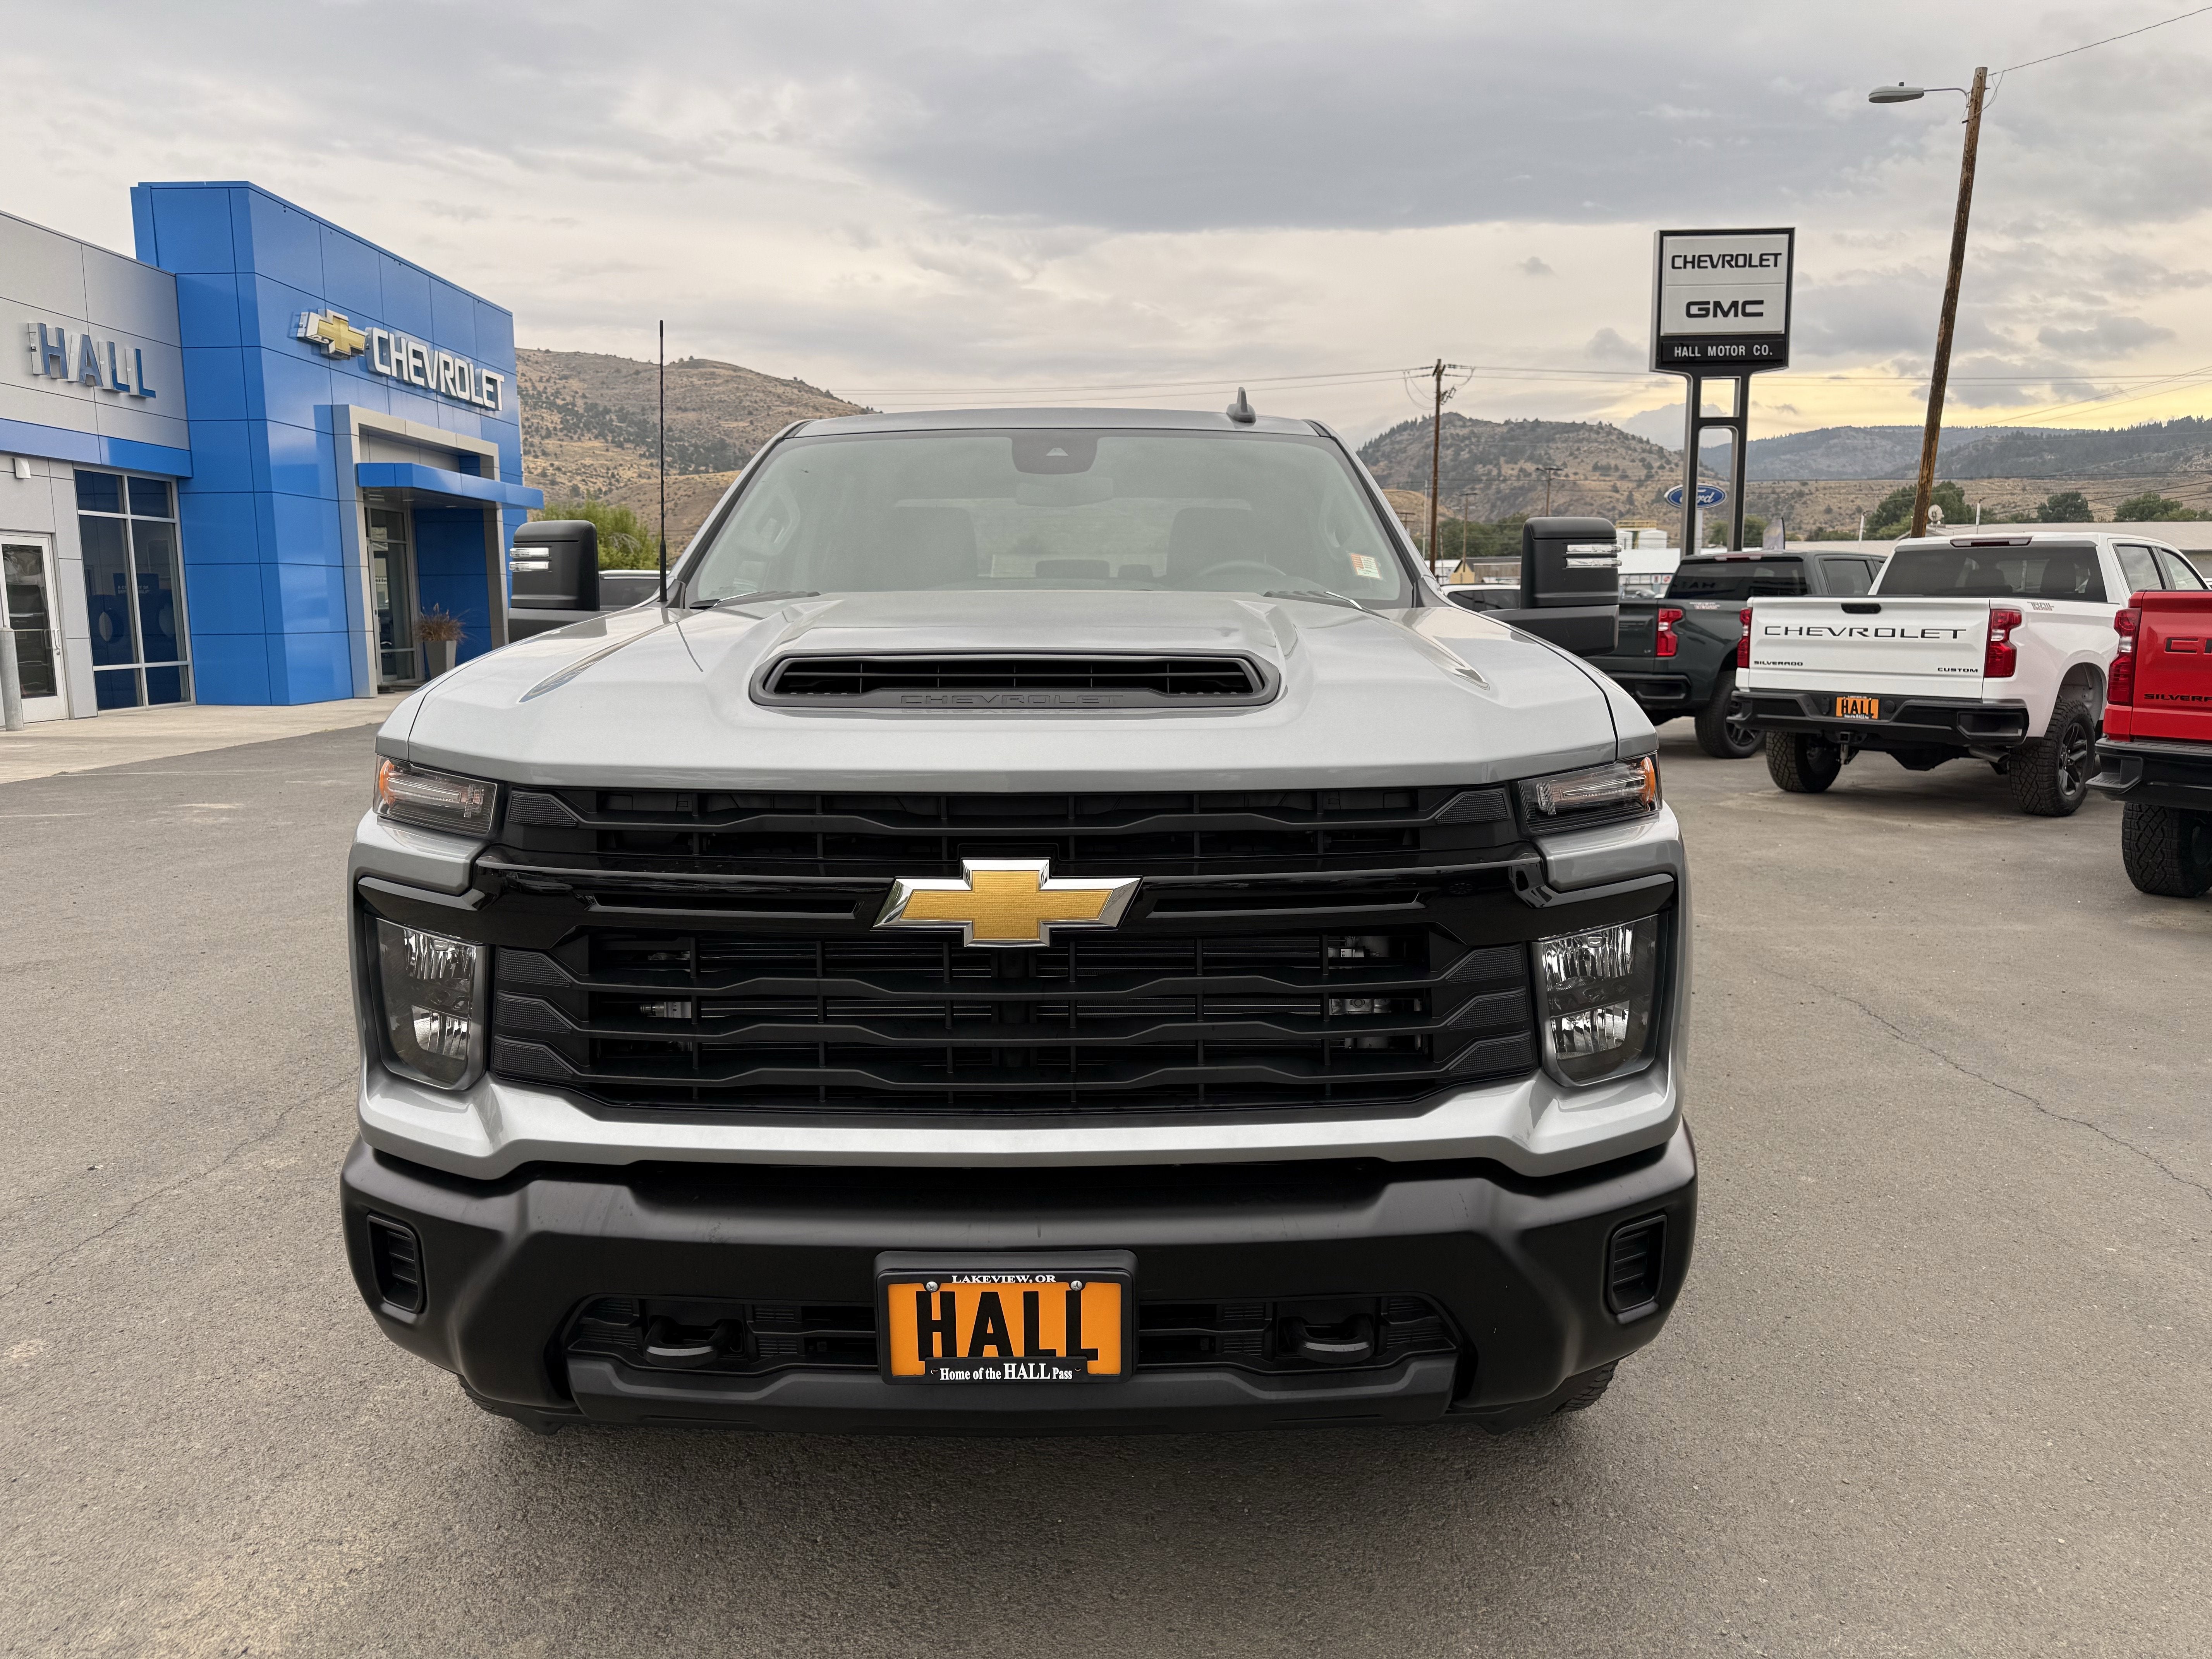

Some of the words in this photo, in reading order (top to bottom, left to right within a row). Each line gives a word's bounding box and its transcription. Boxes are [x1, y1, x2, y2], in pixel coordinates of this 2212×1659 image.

[1671, 252, 1782, 269] CHEVROLET
[1686, 300, 1764, 318] GMC
[1674, 346, 1701, 357] HALL
[1708, 345, 1745, 356] MOTOR
[1753, 344, 1772, 356] CO.
[38, 323, 156, 398] HALL
[373, 328, 505, 411] CHEVROLET
[1765, 626, 1966, 639] CHEVROLET
[2165, 637, 2212, 654] C
[901, 695, 1123, 704] CHEVROLET
[1841, 699, 1874, 716] HALL
[951, 1275, 1033, 1284] LAKEVIEW,
[1035, 1275, 1056, 1283] OR
[915, 1291, 1099, 1361] HALL
[939, 1368, 970, 1380] Home
[973, 1367, 984, 1380] of
[985, 1367, 1002, 1380] the
[1003, 1363, 1050, 1379] HALL
[1052, 1367, 1073, 1379] Pass
